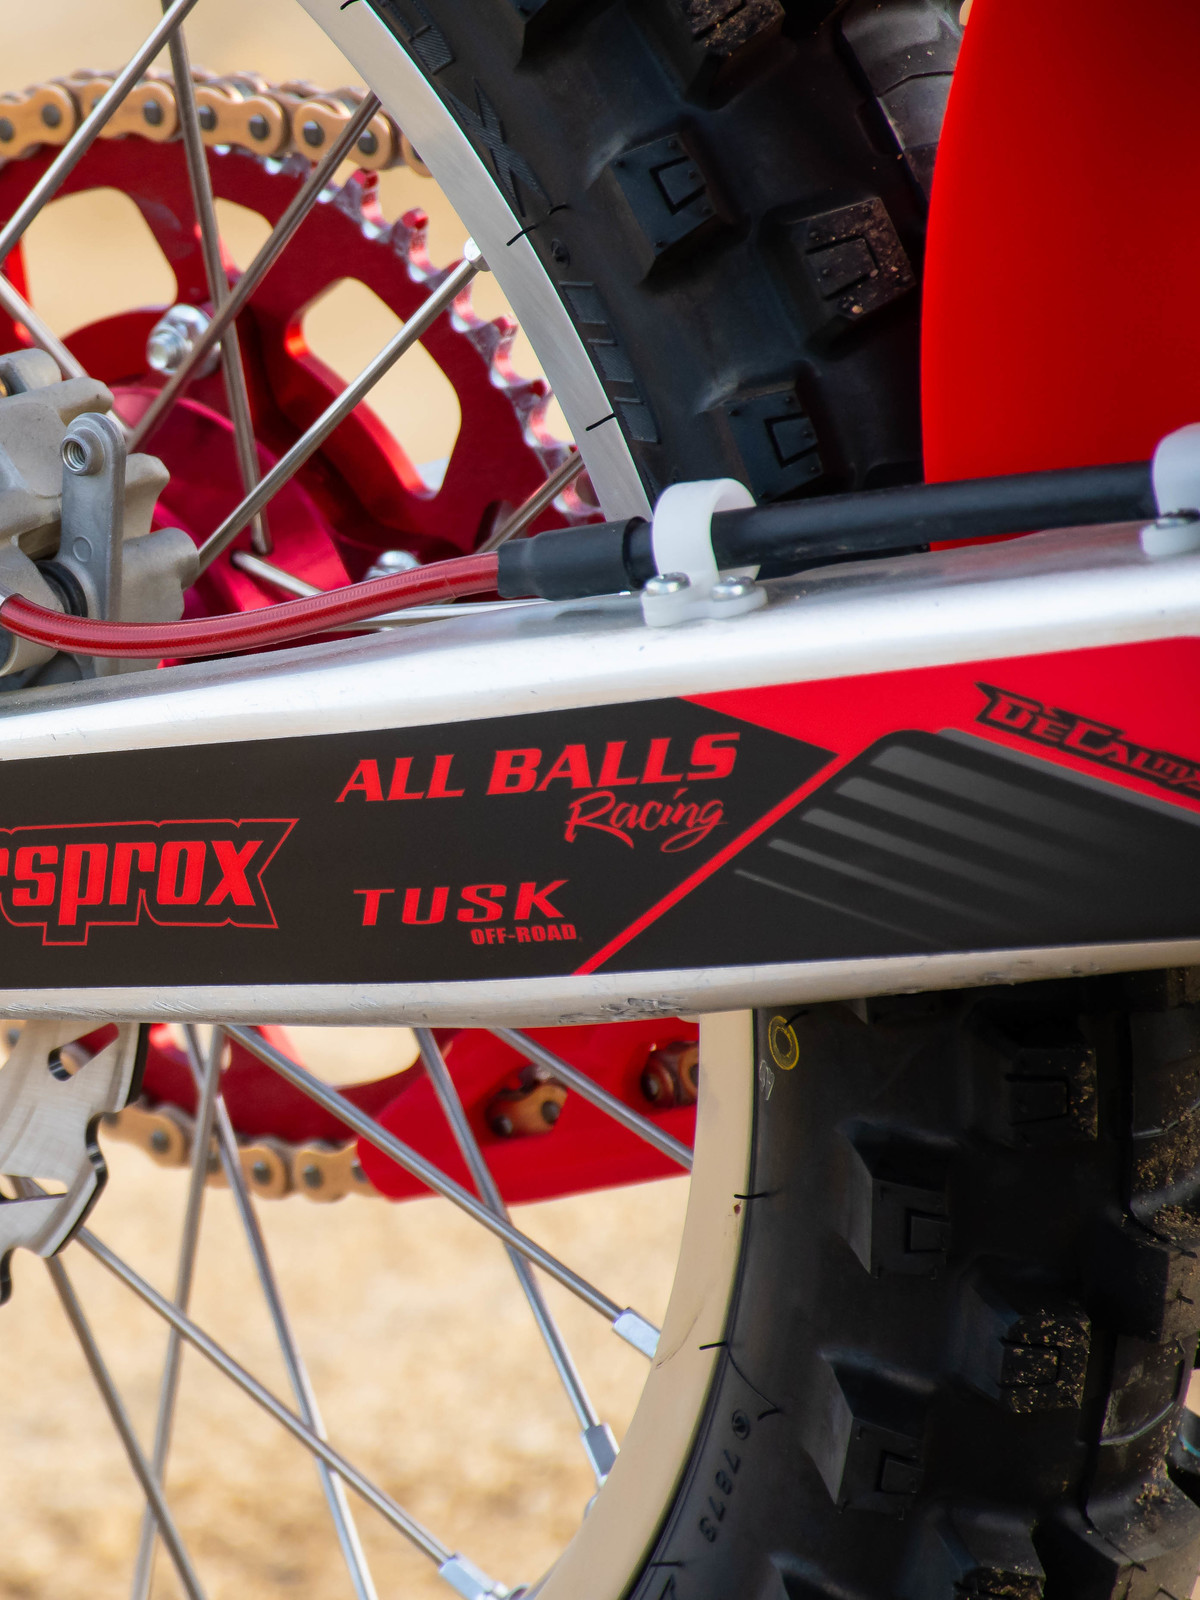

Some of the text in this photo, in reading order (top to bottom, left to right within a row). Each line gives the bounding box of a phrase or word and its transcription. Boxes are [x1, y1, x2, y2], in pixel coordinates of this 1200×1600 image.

[335, 732, 741, 803] ALL BALLS
[564, 788, 728, 853] Racing
[353, 880, 569, 927] TUSK
[471, 924, 577, 945] OFF-ROAD
